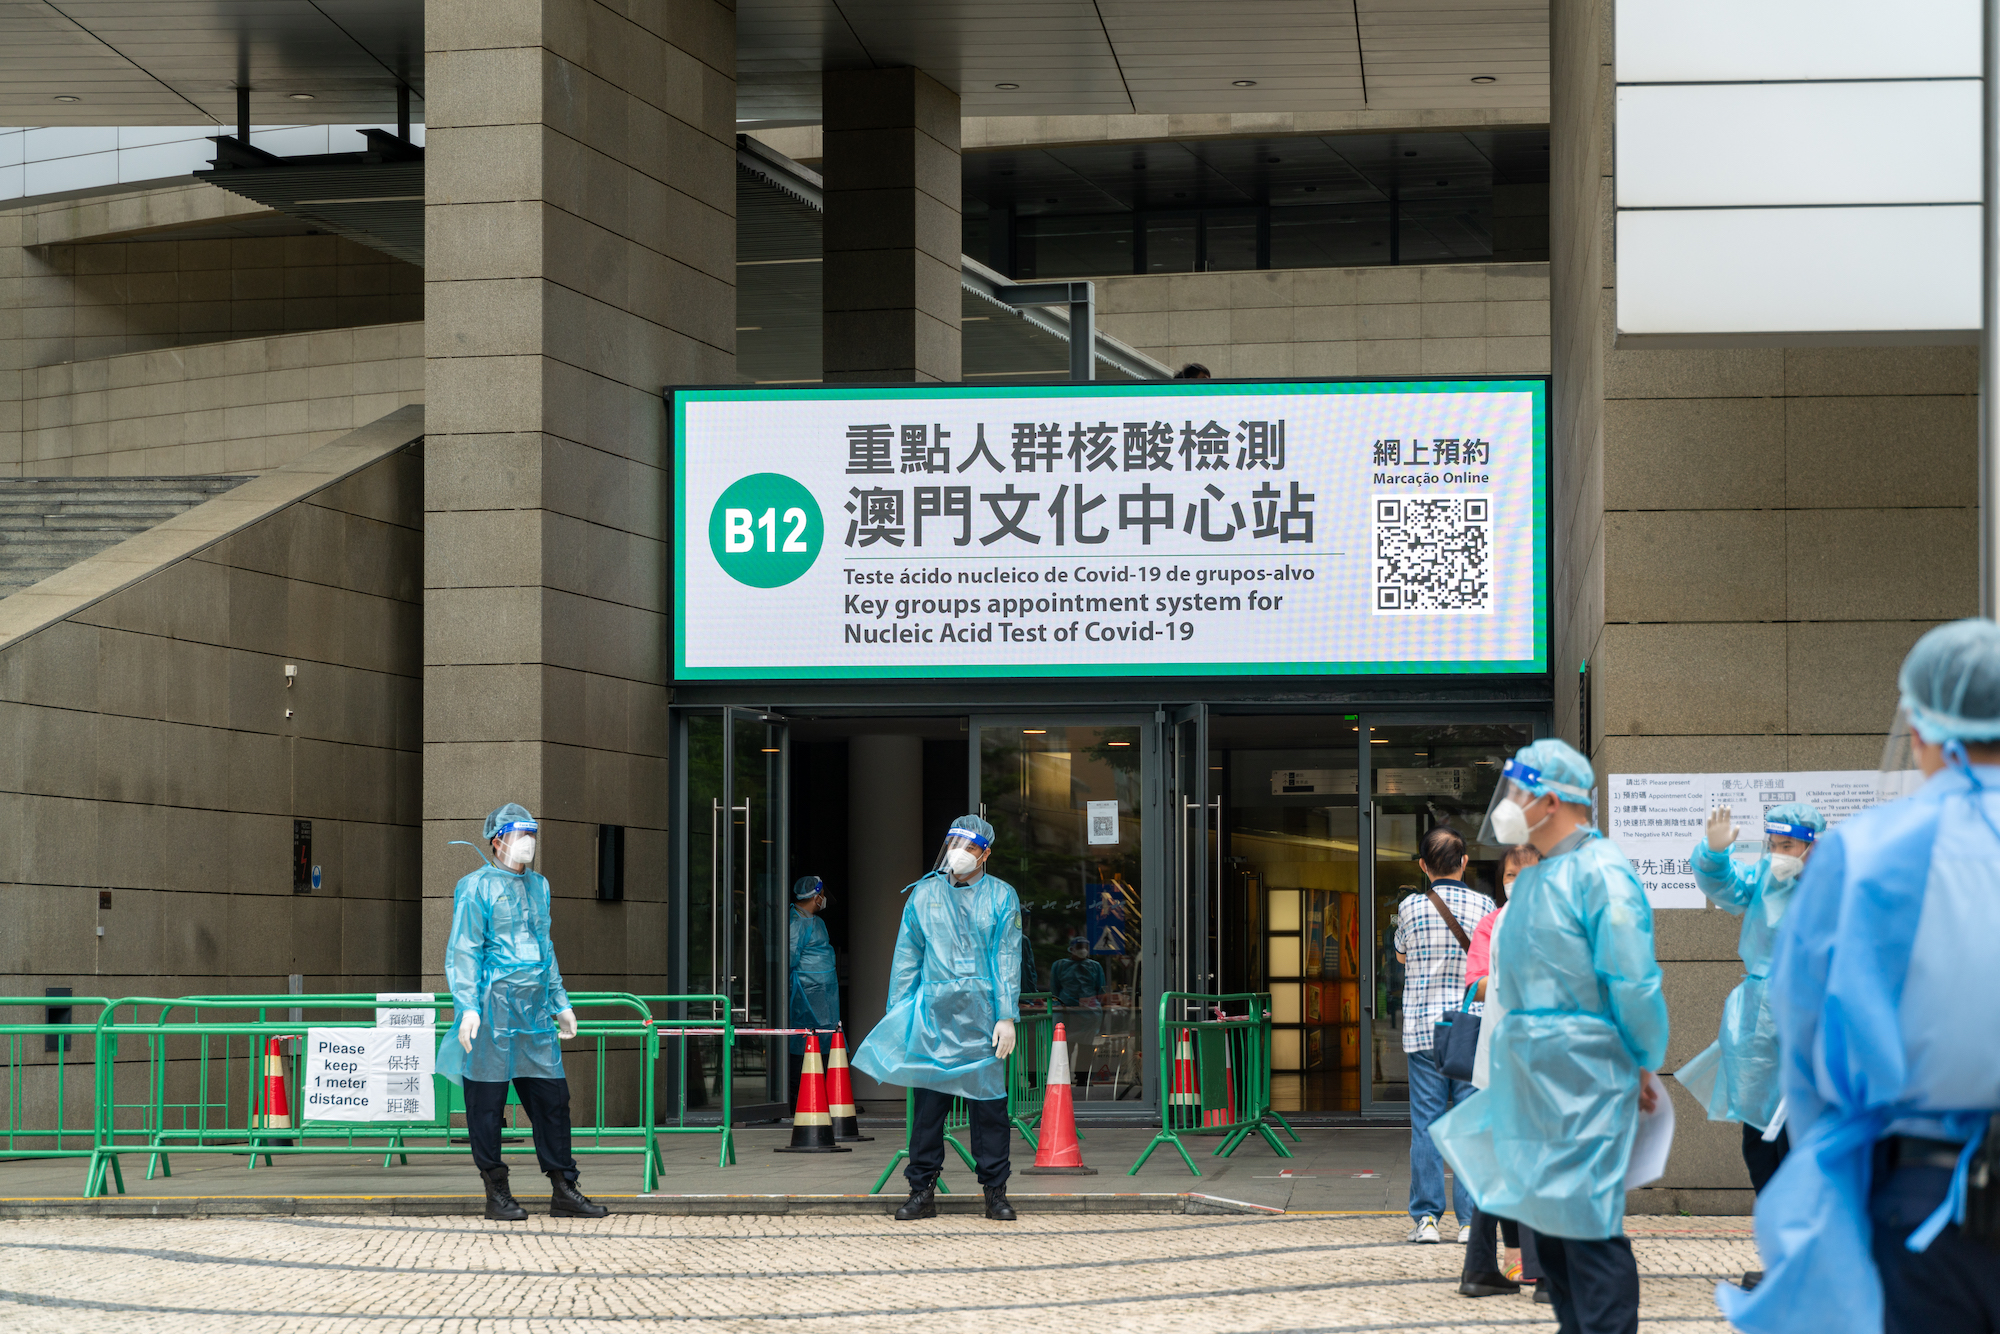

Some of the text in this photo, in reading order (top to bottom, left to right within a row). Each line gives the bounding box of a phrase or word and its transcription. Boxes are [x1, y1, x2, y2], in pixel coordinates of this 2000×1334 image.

[845, 419, 1285, 475] 重點人群核酸檢測
[1373, 438, 1490, 467] 網上預約
[1373, 471, 1489, 487] Marcação Online
[843, 481, 1315, 548] 澳門文化中心站
[724, 507, 808, 553] B12
[843, 564, 1315, 586] Teste ácido nucleico de Covid-19 de grupos-alvo
[844, 590, 1283, 620] Key groups appointment system for
[844, 620, 1194, 644] Nucleic Acid Test of Covid-19
[1626, 778, 1647, 786] 請出示
[1622, 791, 1647, 799] 預約碼
[1622, 805, 1647, 813] 健康碼
[1613, 819, 1622, 827] 3)
[1634, 831, 1661, 839] Negative
[389, 1014, 425, 1027] 預約碼
[319, 1041, 366, 1055] Please
[395, 1033, 412, 1050] 請
[324, 1059, 358, 1074] keep
[386, 1055, 420, 1071] 保持
[314, 1076, 367, 1089] 1 meter
[387, 1076, 420, 1092] 一米
[309, 1092, 369, 1107] distance
[386, 1098, 420, 1114] 距離
